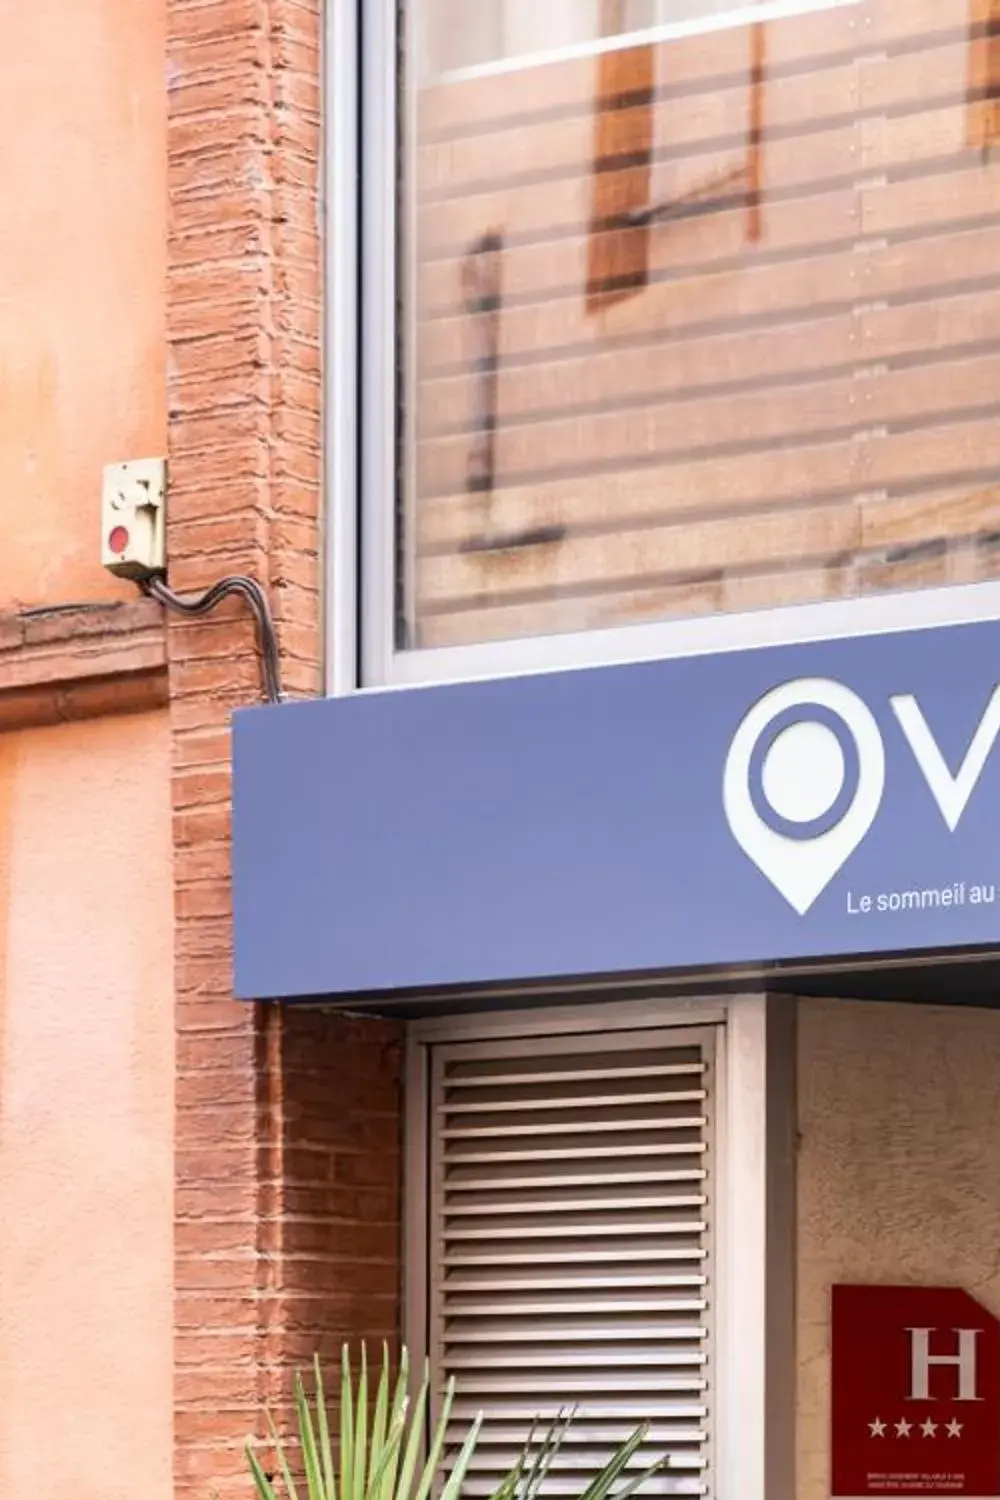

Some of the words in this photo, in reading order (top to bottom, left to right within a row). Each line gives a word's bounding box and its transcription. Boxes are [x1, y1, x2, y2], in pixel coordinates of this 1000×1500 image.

[846, 891, 872, 915] Le
[876, 881, 966, 911] sommeil
[969, 884, 995, 905] au
[902, 1326, 987, 1402] H
